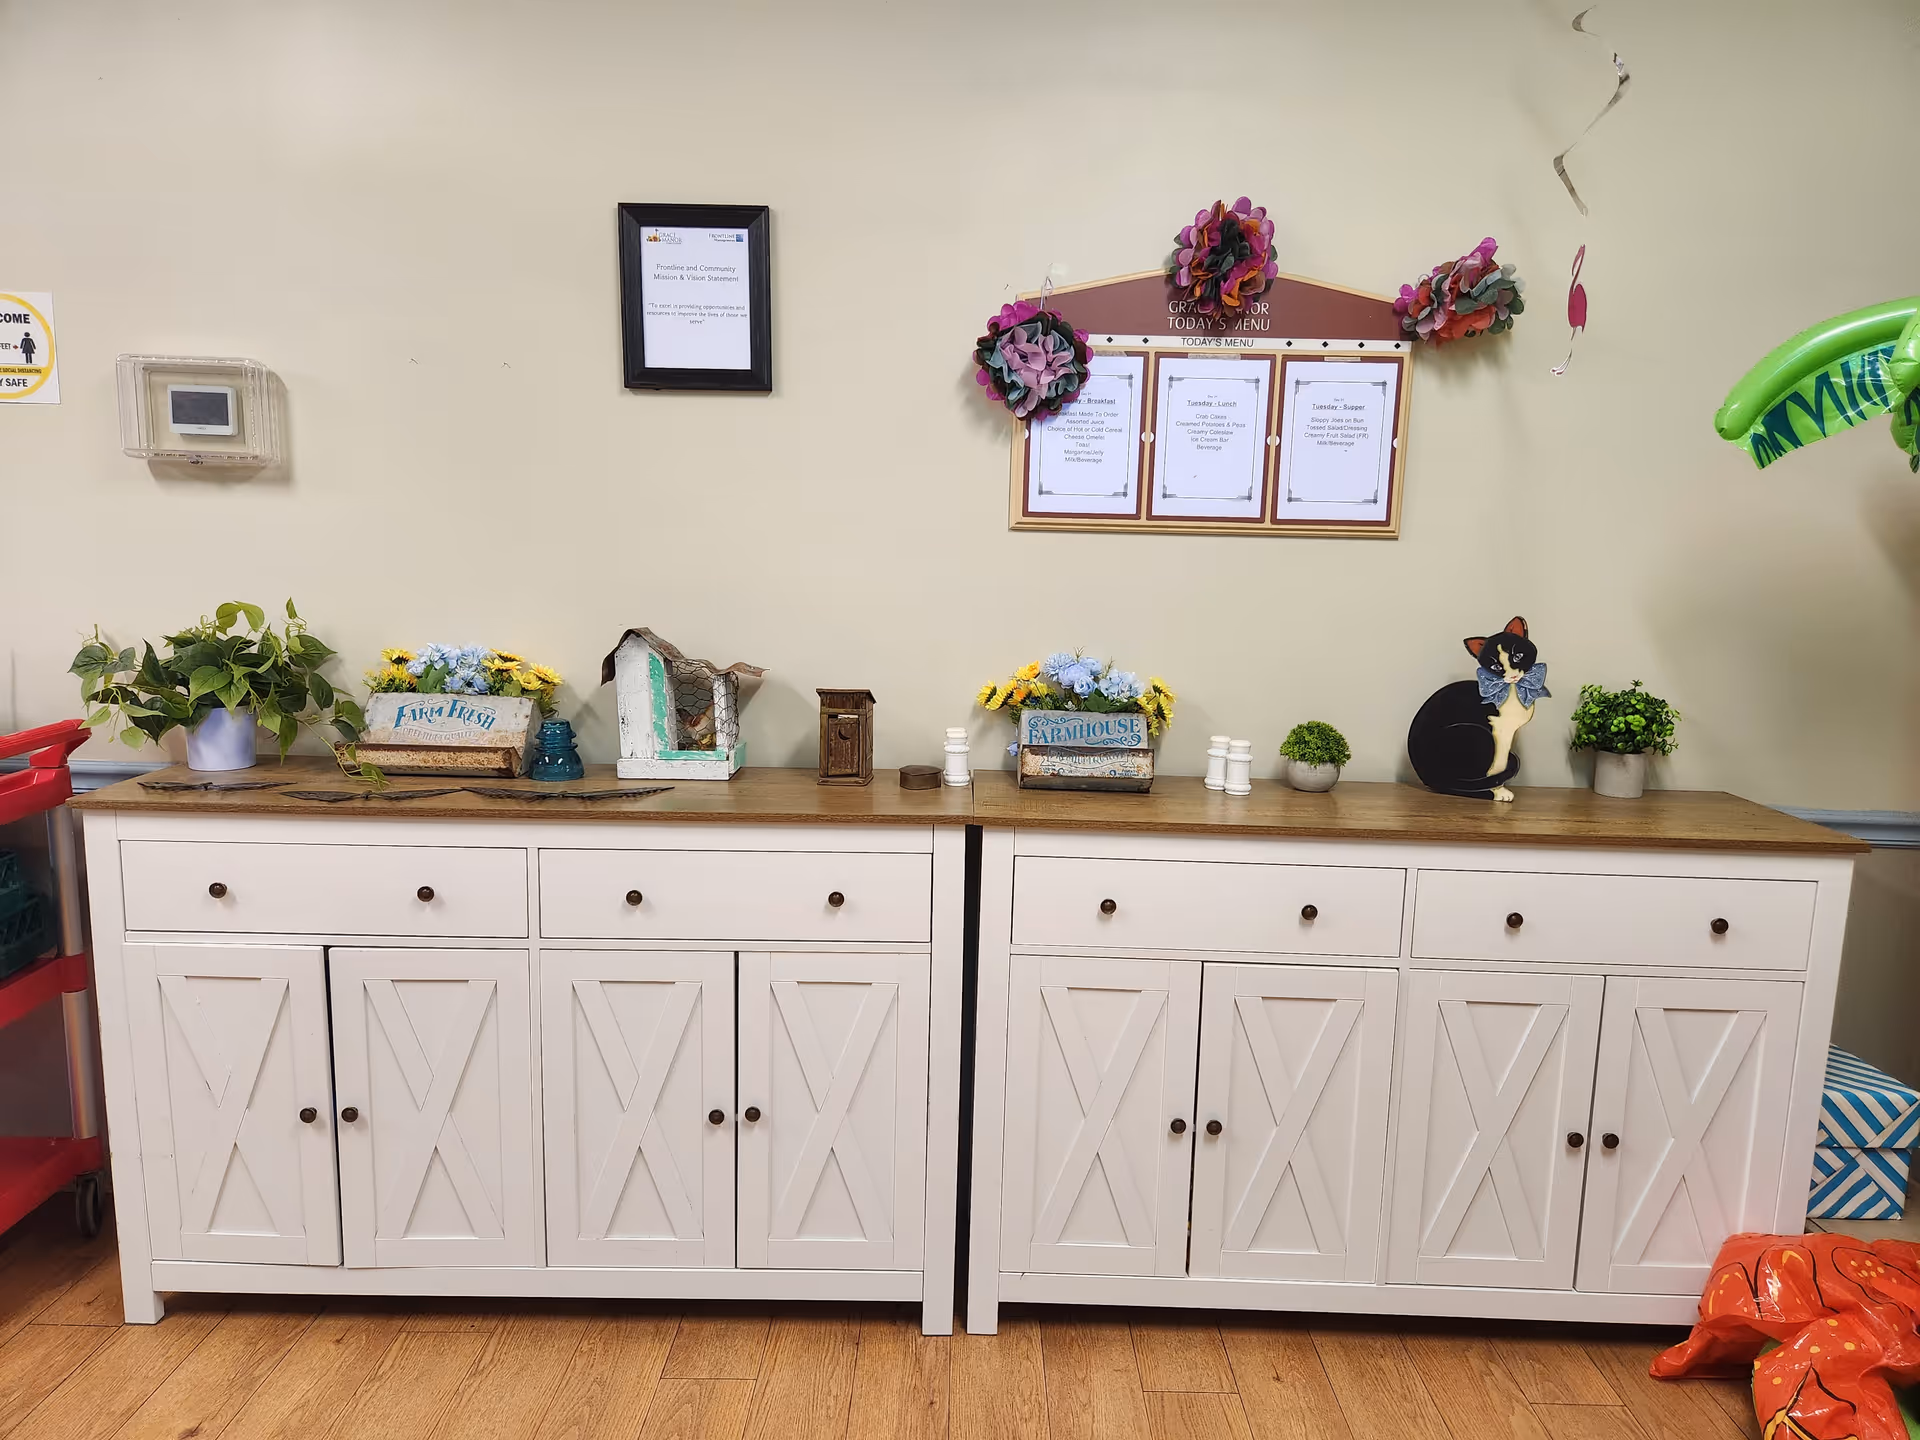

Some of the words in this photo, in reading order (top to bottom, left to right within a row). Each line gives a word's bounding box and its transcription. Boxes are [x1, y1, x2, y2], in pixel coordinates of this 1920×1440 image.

[699, 265, 736, 273] Community
[1181, 337, 1222, 346] TODAY'S
[1225, 339, 1254, 347] MENU
[5, 378, 28, 387] SAFE
[394, 701, 444, 728] FARM
[448, 699, 496, 731] FRESH
[1028, 718, 1141, 744] FARMHOUSE
